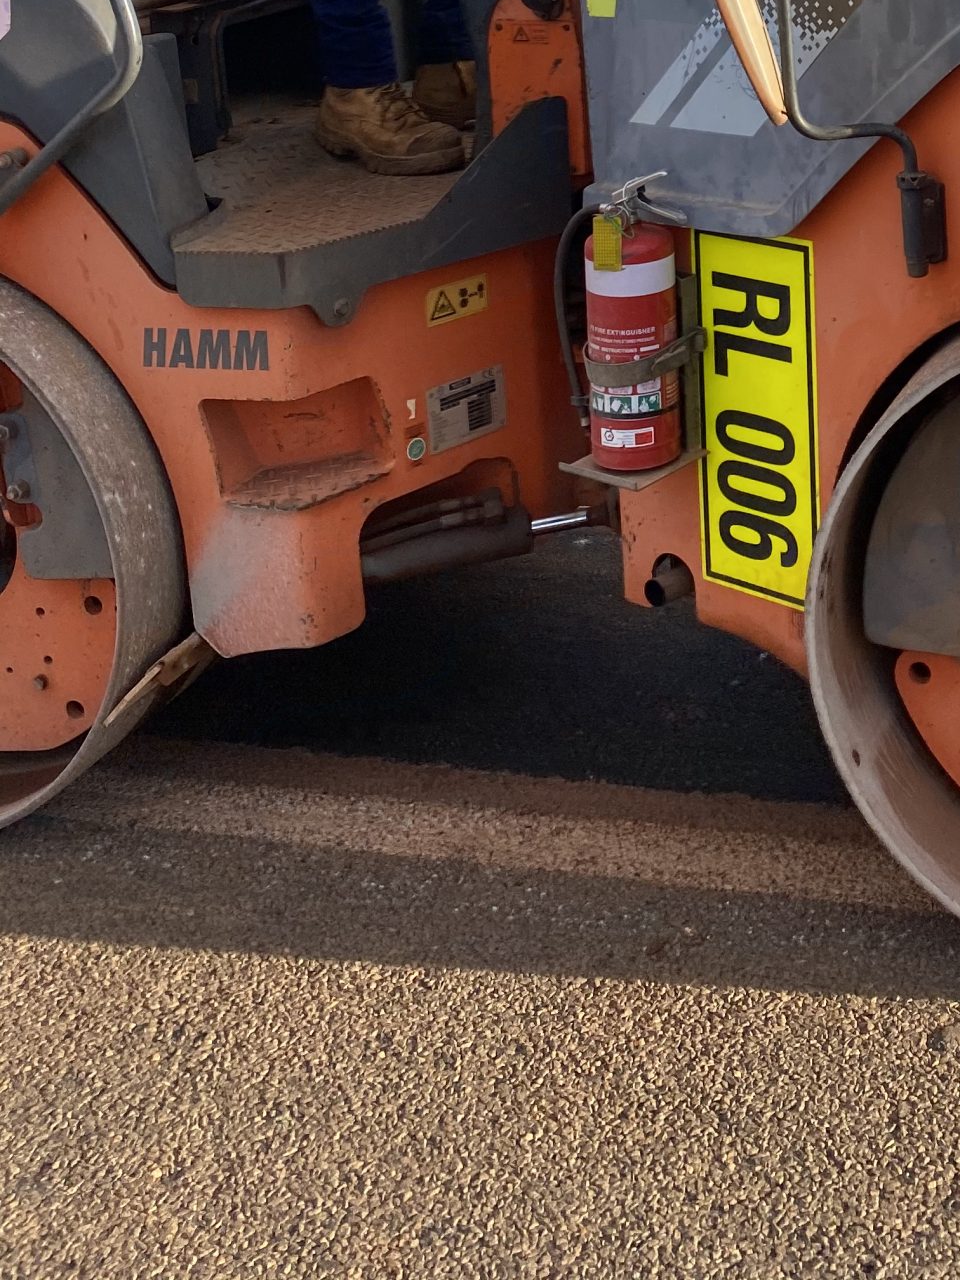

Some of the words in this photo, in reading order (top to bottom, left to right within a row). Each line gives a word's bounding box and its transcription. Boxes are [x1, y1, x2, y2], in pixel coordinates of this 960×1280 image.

[143, 327, 270, 371] HAMM
[594, 326, 606, 335] FIRE
[606, 326, 656, 336] EXTINGUISHER
[711, 270, 793, 377] RL
[715, 409, 799, 568] 006
